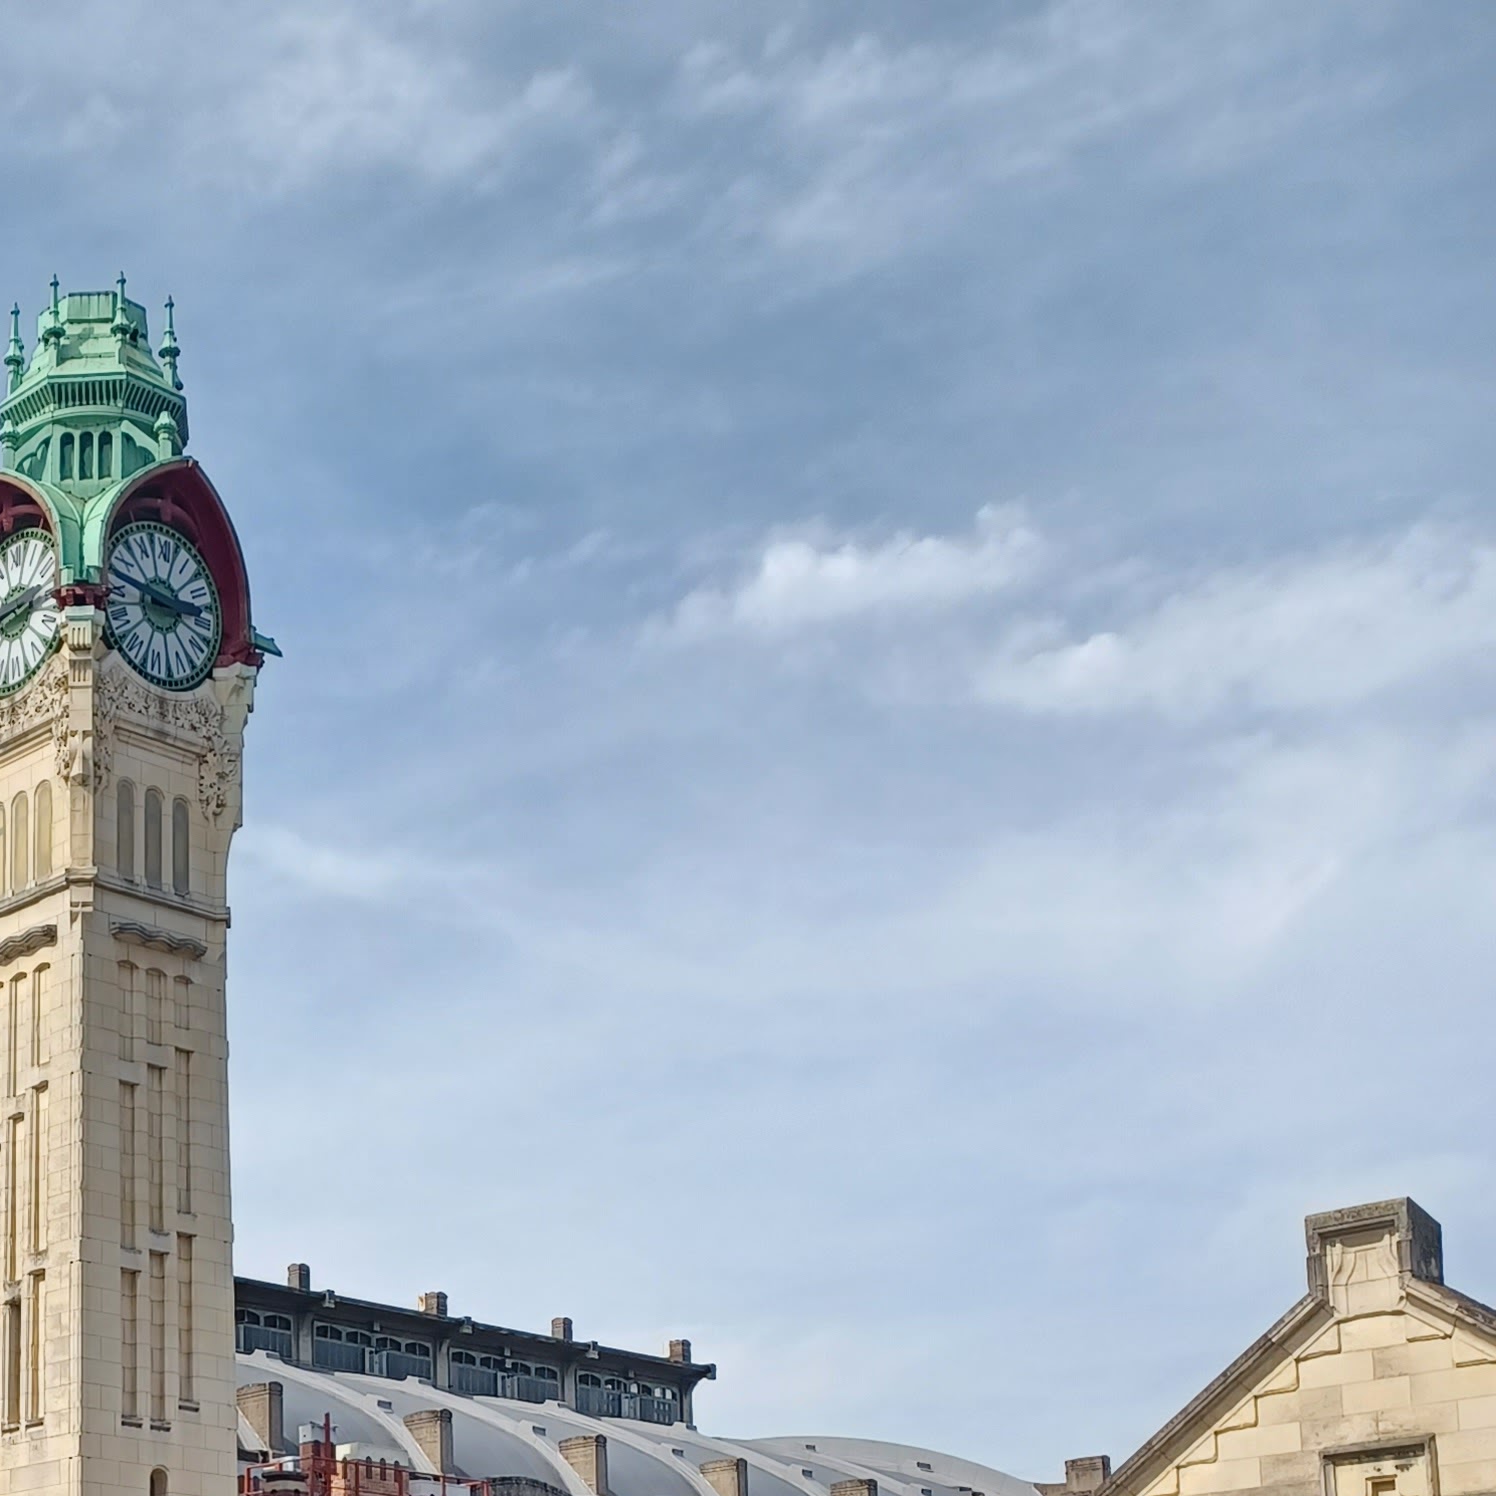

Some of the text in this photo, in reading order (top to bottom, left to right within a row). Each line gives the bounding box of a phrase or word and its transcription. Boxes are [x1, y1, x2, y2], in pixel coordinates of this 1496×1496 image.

[29, 543, 38, 567] I
[133, 535, 150, 561] XI
[157, 536, 171, 564] XII
[39, 556, 56, 579] II
[114, 549, 135, 573] X
[178, 557, 190, 575] I
[189, 585, 207, 600] II
[30, 641, 42, 662] V
[175, 650, 186, 675] V
